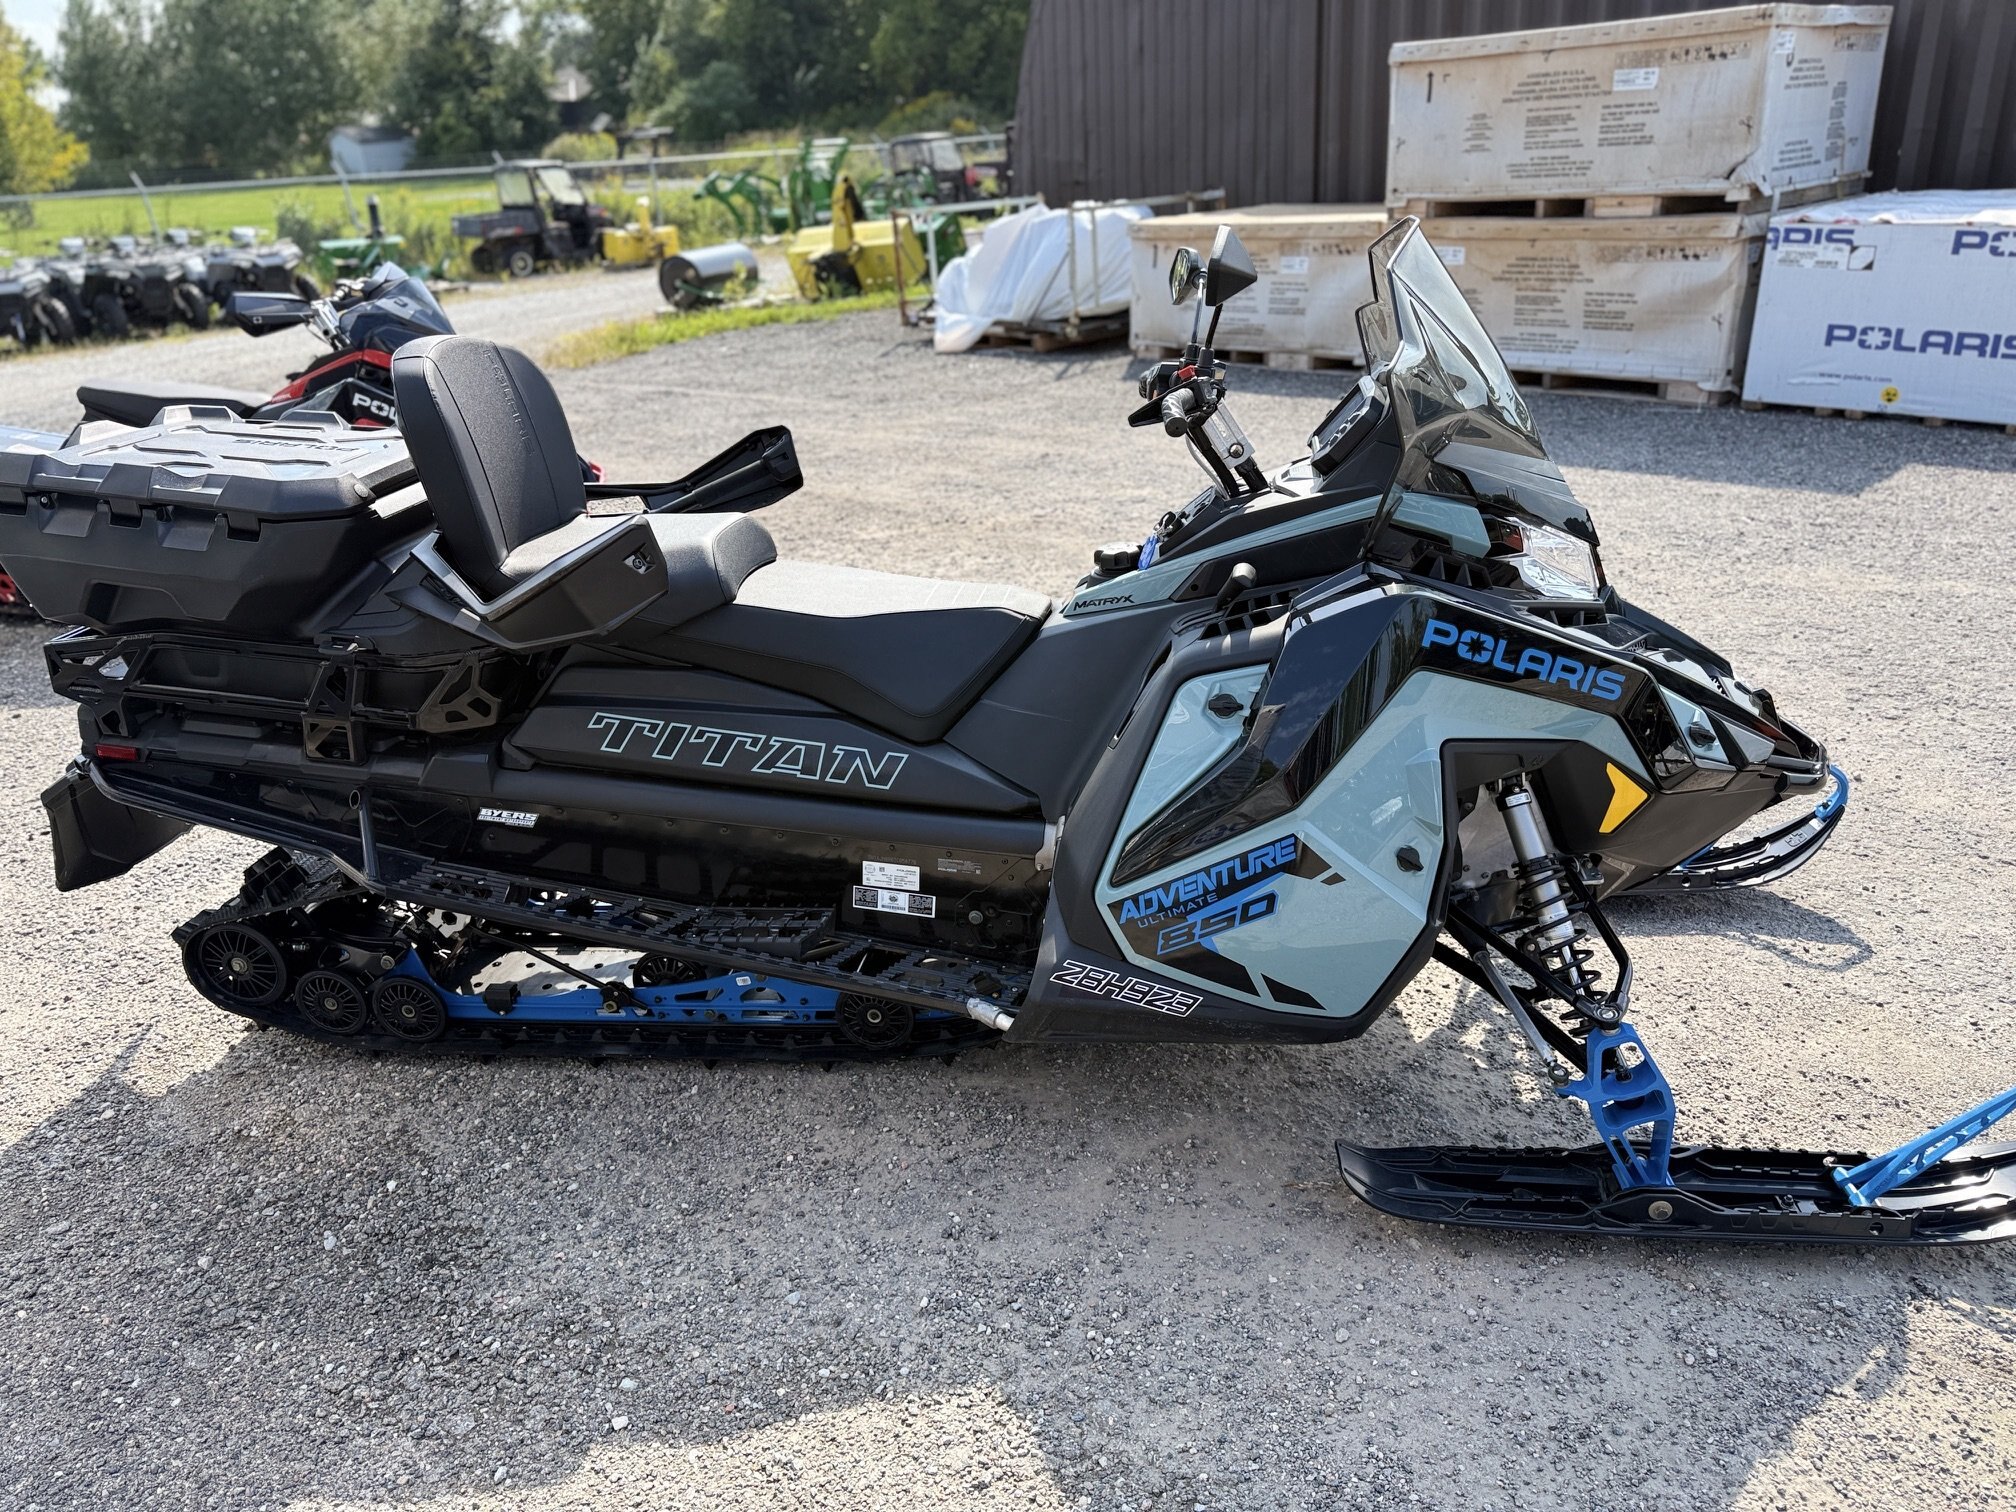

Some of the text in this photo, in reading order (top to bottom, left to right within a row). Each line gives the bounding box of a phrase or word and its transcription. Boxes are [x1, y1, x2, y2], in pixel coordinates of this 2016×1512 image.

[1073, 594, 1135, 612] MATRYX
[1421, 618, 1626, 701] POLARIS
[587, 711, 910, 790] TITAN
[480, 808, 539, 821] BYERS
[1119, 836, 1297, 924] ADVENTURE
[1137, 893, 1219, 929] ULTIMATE
[1156, 889, 1280, 956] 850
